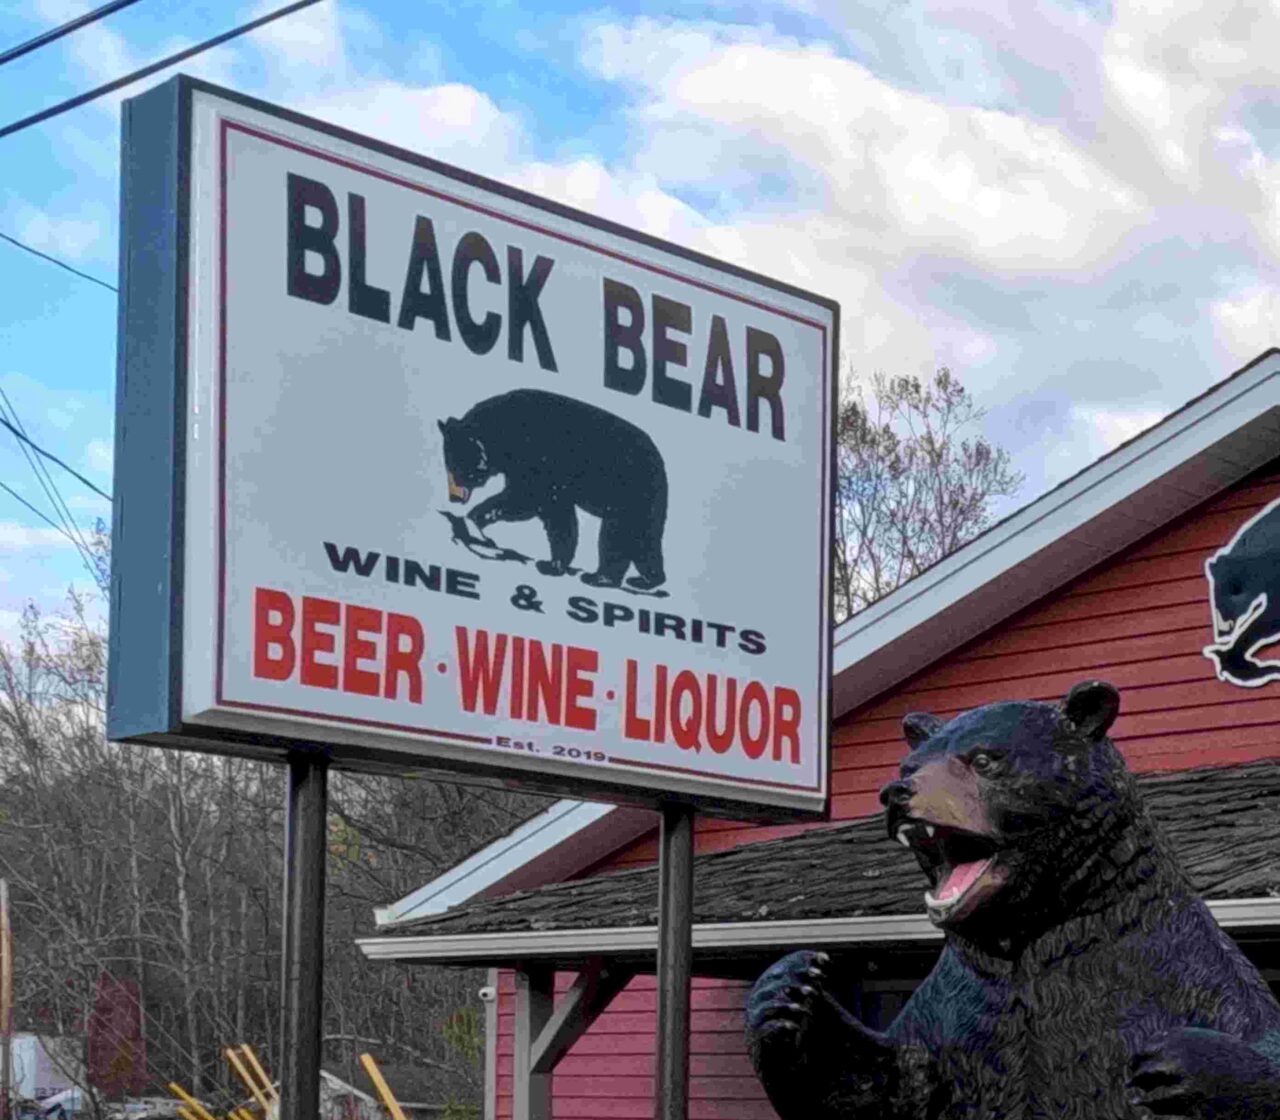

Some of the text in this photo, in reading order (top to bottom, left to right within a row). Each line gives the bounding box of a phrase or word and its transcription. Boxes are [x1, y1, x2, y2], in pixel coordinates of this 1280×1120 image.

[287, 171, 786, 442] BLACK BEAR
[323, 541, 768, 655] WINE & SPIRITS
[253, 586, 802, 765] BEER WINE LIQUOR
[496, 736, 606, 762] Est. 2019
